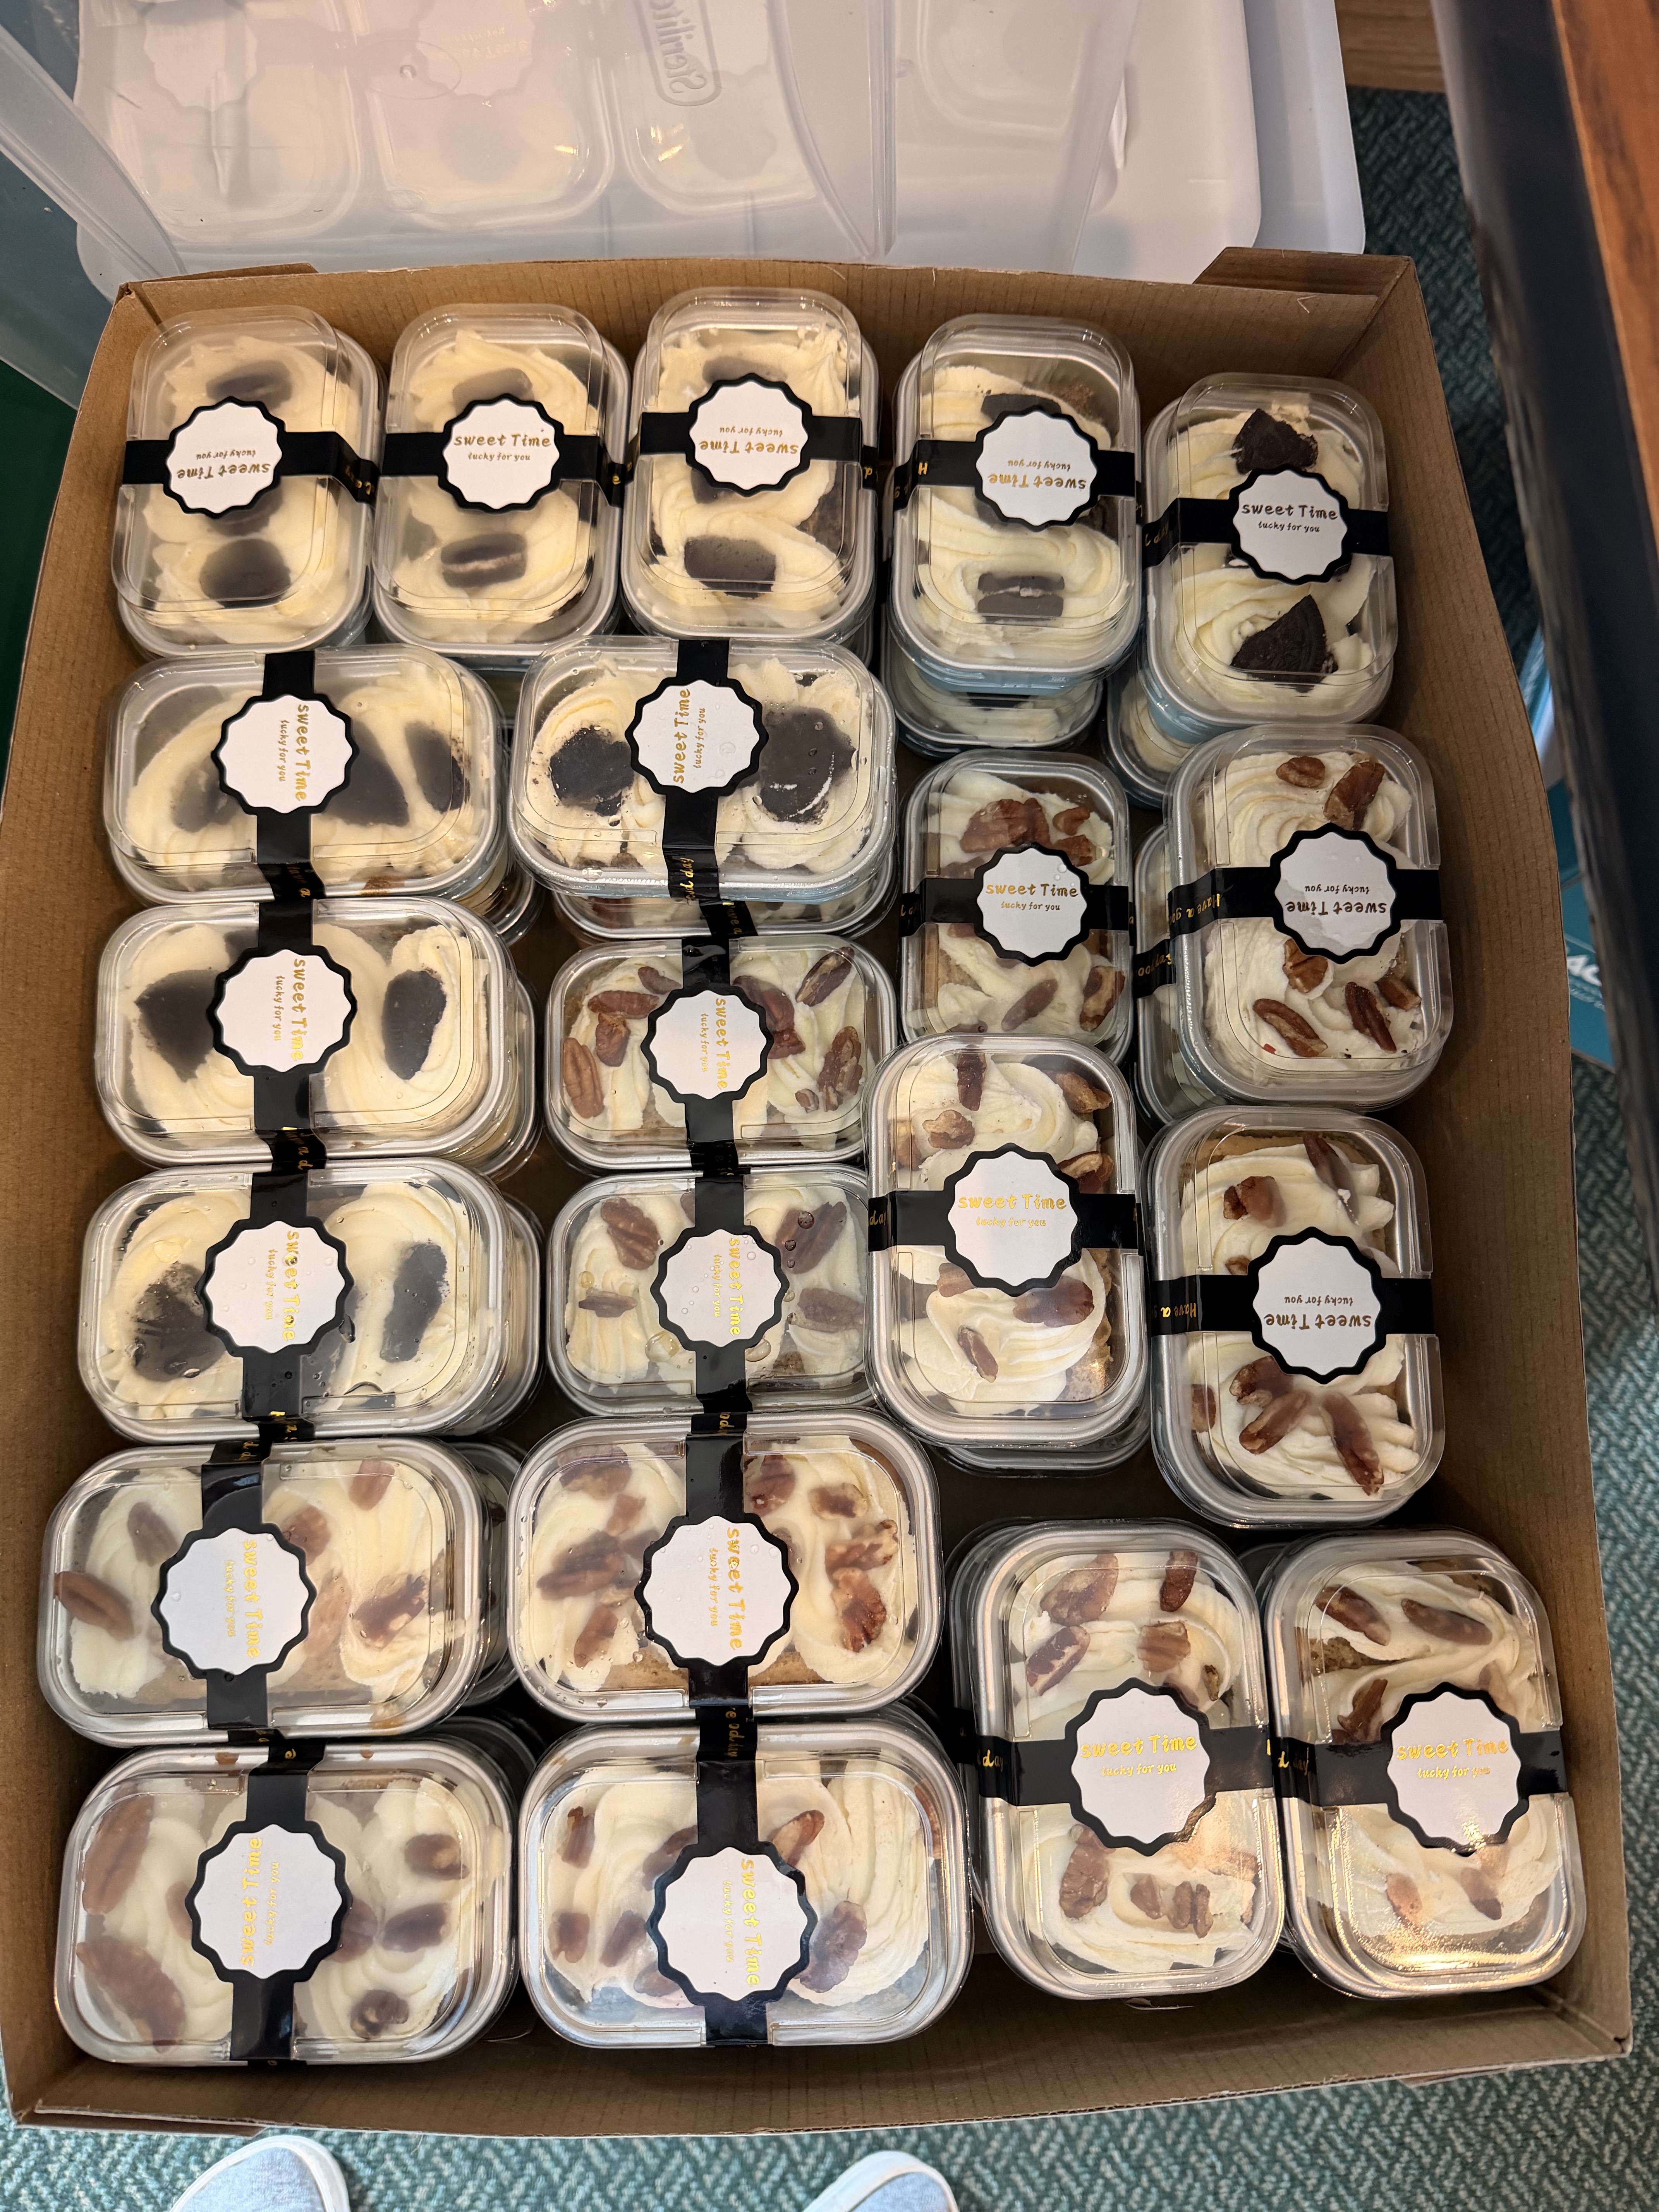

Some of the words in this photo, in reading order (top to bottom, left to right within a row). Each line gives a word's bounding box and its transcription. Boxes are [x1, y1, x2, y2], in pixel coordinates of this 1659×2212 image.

[719, 425, 736, 433] you
[737, 427, 754, 436] for
[453, 434, 507, 447] sweet
[511, 433, 551, 448] Time
[699, 440, 740, 454] Time
[745, 441, 799, 455] sweet
[196, 451, 212, 460] you
[212, 450, 228, 459] for
[497, 452, 513, 461] for
[1008, 459, 1025, 467] you
[176, 466, 214, 480] Time
[217, 463, 271, 477] sweet
[1026, 460, 1042, 470] for
[987, 473, 1029, 488] Time
[1033, 475, 1087, 492] sweet
[1241, 504, 1294, 517] sweet
[1298, 504, 1338, 520] Time
[1286, 522, 1303, 531] for
[673, 688, 691, 728] Time
[698, 708, 706, 724] you
[295, 704, 310, 756] sweet
[695, 725, 707, 741] for
[278, 747, 289, 763] for
[673, 732, 688, 784] sweet
[276, 764, 286, 782] you
[294, 759, 311, 802] Time
[680, 857, 694, 878] day
[985, 883, 1036, 896] sweet
[1040, 883, 1079, 898] Time
[1304, 884, 1323, 892] you
[1324, 885, 1340, 895] for
[1028, 902, 1044, 910] for
[1196, 893, 1220, 913] Have
[1285, 901, 1329, 916] Time
[1333, 901, 1387, 915] sweet
[1186, 908, 1195, 917] a
[291, 958, 307, 1013] sweet
[274, 1005, 284, 1022] for
[715, 998, 729, 1047] sweet
[272, 1023, 282, 1041] you
[290, 1017, 307, 1061] Time
[701, 1040, 709, 1055] for
[700, 1056, 708, 1072] you
[716, 1050, 731, 1090] Time
[957, 1194, 1017, 1209] sweet
[1021, 1193, 1067, 1210] Time
[1008, 1217, 1026, 1227] for
[1027, 1219, 1046, 1229] you
[283, 1230, 300, 1290] sweet
[728, 1237, 743, 1291] sweet
[713, 1282, 722, 1298] for
[1284, 1294, 1303, 1304] you
[1305, 1296, 1322, 1307] for
[263, 1300, 273, 1320] you
[712, 1300, 721, 1317] you
[728, 1294, 744, 1337] Time
[1161, 1307, 1171, 1318] a
[1174, 1303, 1196, 1318] Have
[282, 1294, 300, 1341] Time
[1263, 1314, 1310, 1331] Time
[1314, 1314, 1372, 1329] sweet
[726, 1527, 744, 1594] sweet
[242, 1539, 260, 1603] sweet
[225, 1595, 236, 1614] for
[708, 1606, 718, 1627] you
[728, 1598, 746, 1650] Time
[244, 1608, 263, 1659] Time
[1080, 1737, 1144, 1759] sweet
[1148, 1734, 1198, 1754] Time
[1395, 1740, 1459, 1760] sweet
[1462, 1738, 1510, 1757] Time
[983, 1749, 1003, 1772] day
[1136, 1763, 1155, 1776] for
[1156, 1763, 1177, 1776] you
[1451, 1765, 1470, 1778] for
[241, 1837, 263, 1891] Time
[270, 1862, 280, 1884] you
[266, 1887, 277, 1907] for
[740, 1858, 760, 1928] sweet
[240, 1896, 258, 1967] sweet
[724, 1918, 735, 1938] for
[723, 1941, 734, 1963] you
[744, 1933, 763, 1987] Time
